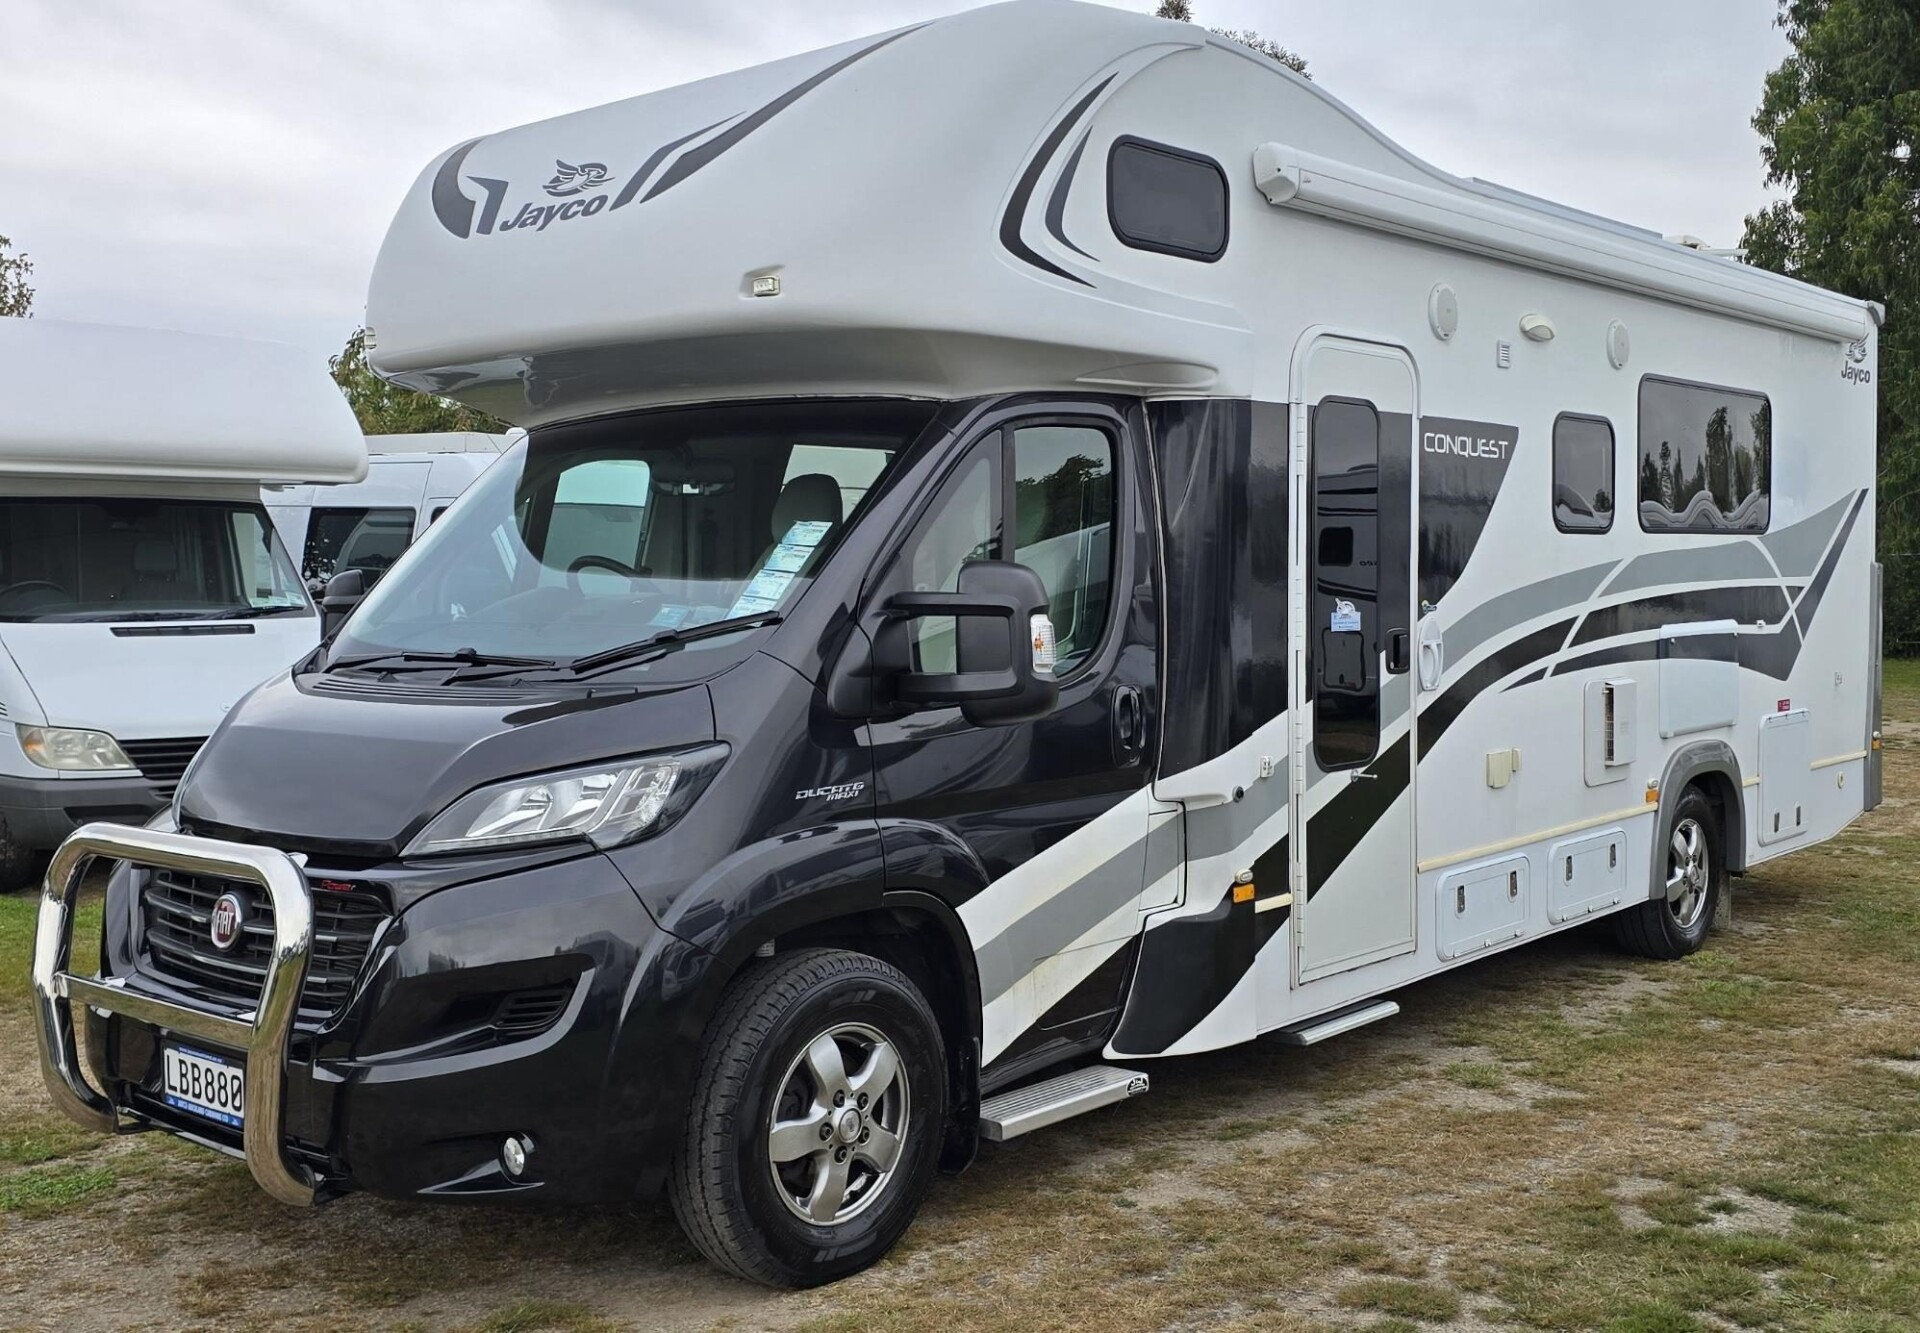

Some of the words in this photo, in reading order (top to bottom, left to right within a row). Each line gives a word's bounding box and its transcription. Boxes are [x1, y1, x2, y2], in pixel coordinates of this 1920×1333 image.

[499, 194, 609, 232] Jayco
[1841, 360, 1871, 385] Jayco
[1424, 432, 1508, 459] CONQUEST
[795, 781, 865, 800] DUCATO
[216, 910, 235, 936] FIAT
[166, 1054, 243, 1112] LBB880
